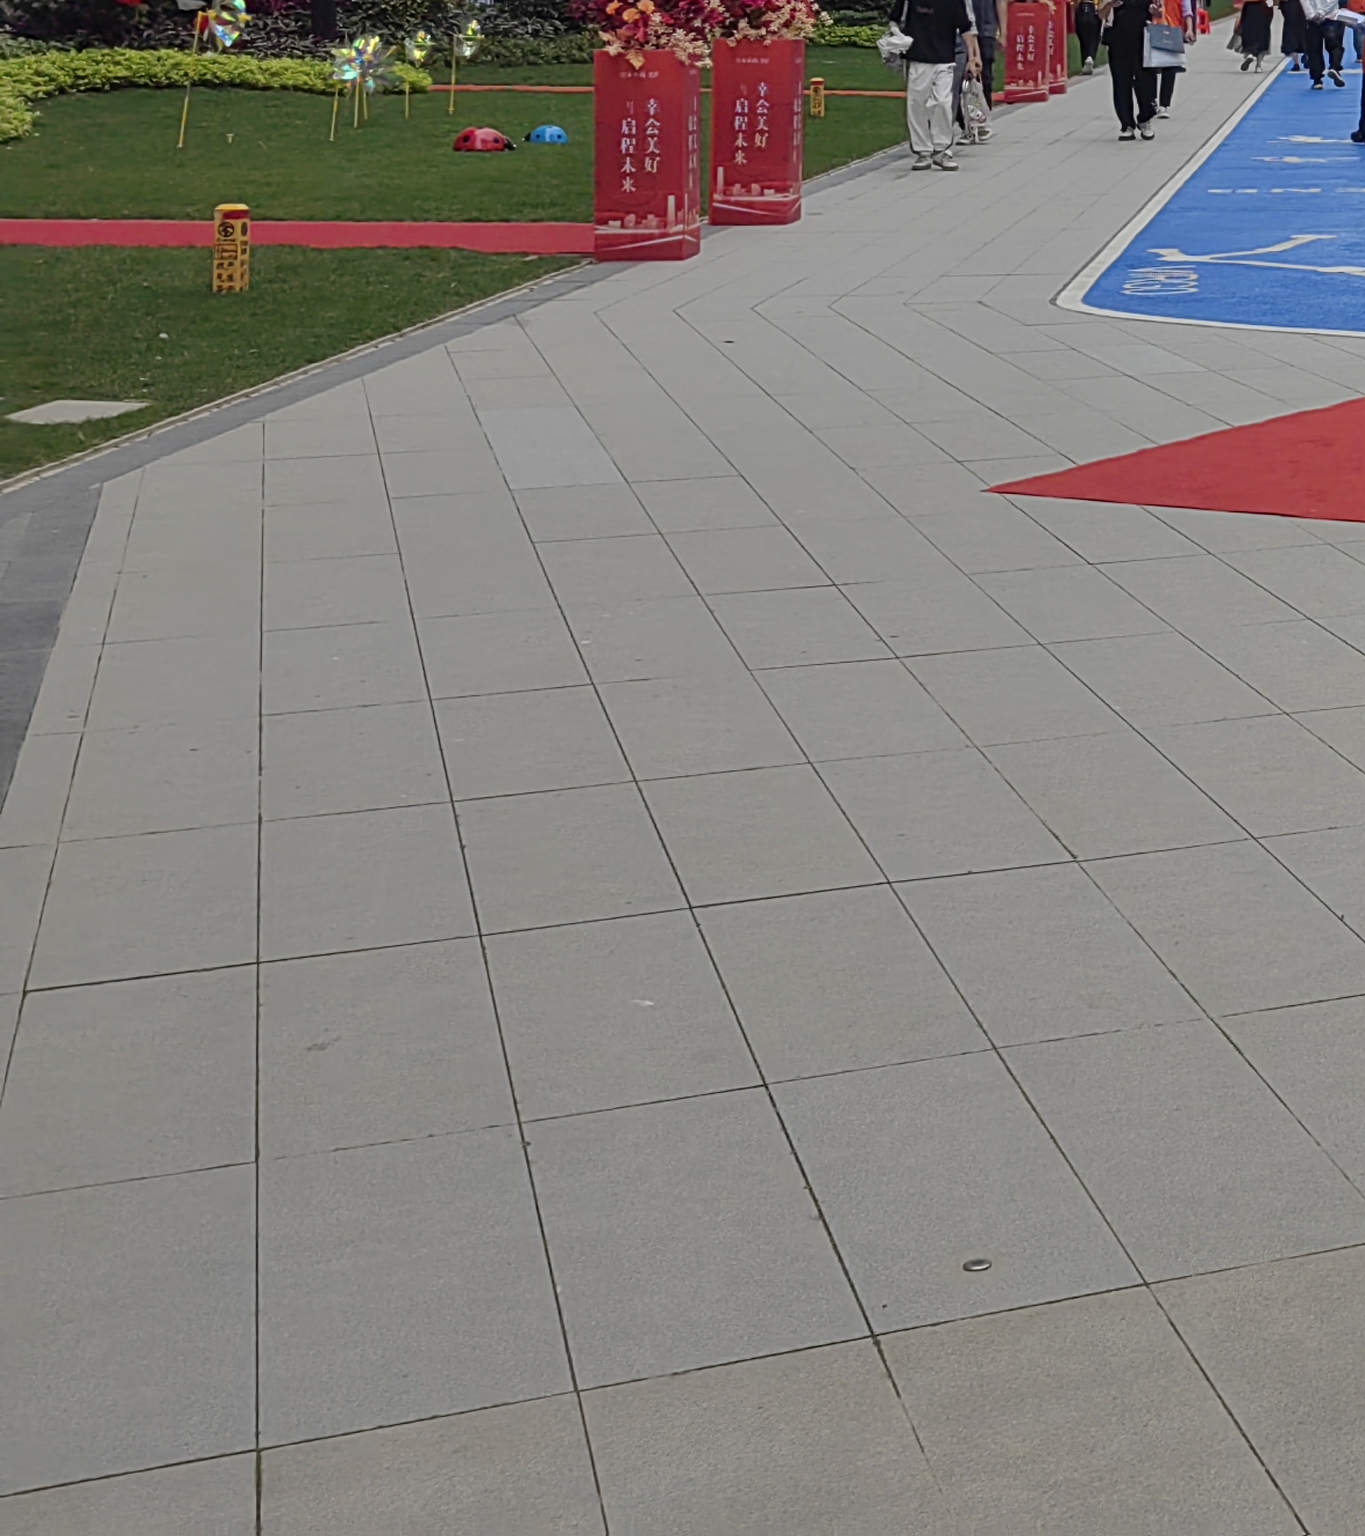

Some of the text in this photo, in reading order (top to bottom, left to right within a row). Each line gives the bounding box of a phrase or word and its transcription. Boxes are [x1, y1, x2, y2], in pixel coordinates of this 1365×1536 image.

[644, 98, 661, 173] 幸会美好
[755, 82, 770, 149] 幸会美好
